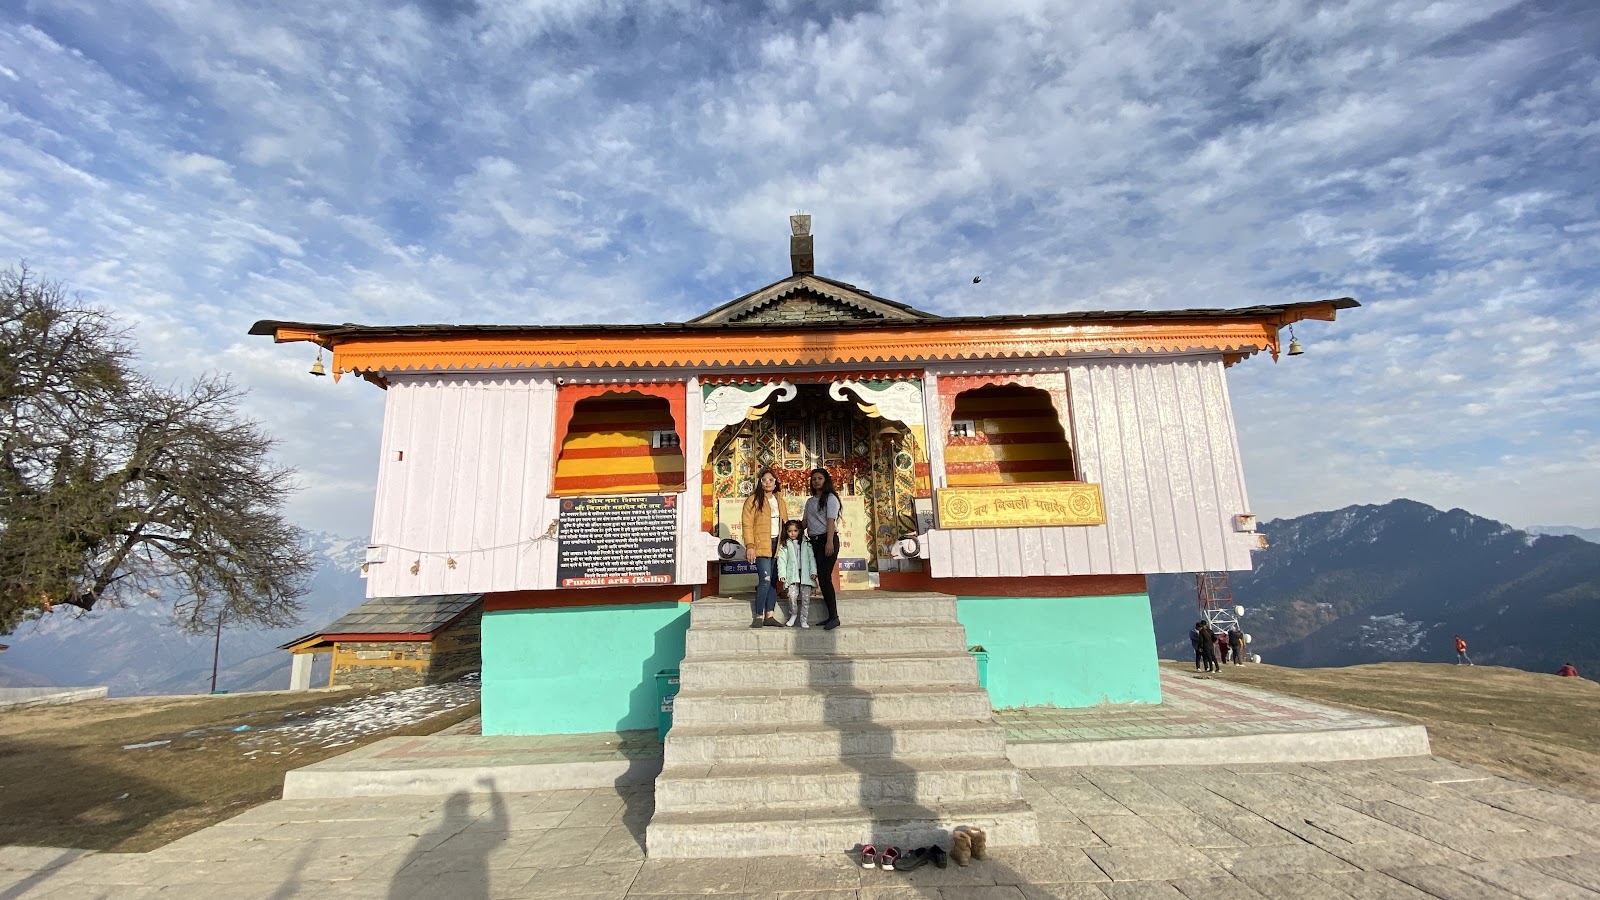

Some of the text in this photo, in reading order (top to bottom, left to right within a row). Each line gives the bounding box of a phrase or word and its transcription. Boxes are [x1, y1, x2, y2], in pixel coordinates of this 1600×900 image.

[973, 504, 989, 516] जय
[993, 495, 1029, 511] बिजली
[1035, 499, 1067, 515] महादेव
[565, 575, 668, 586] Purohit arts (Kullu)
